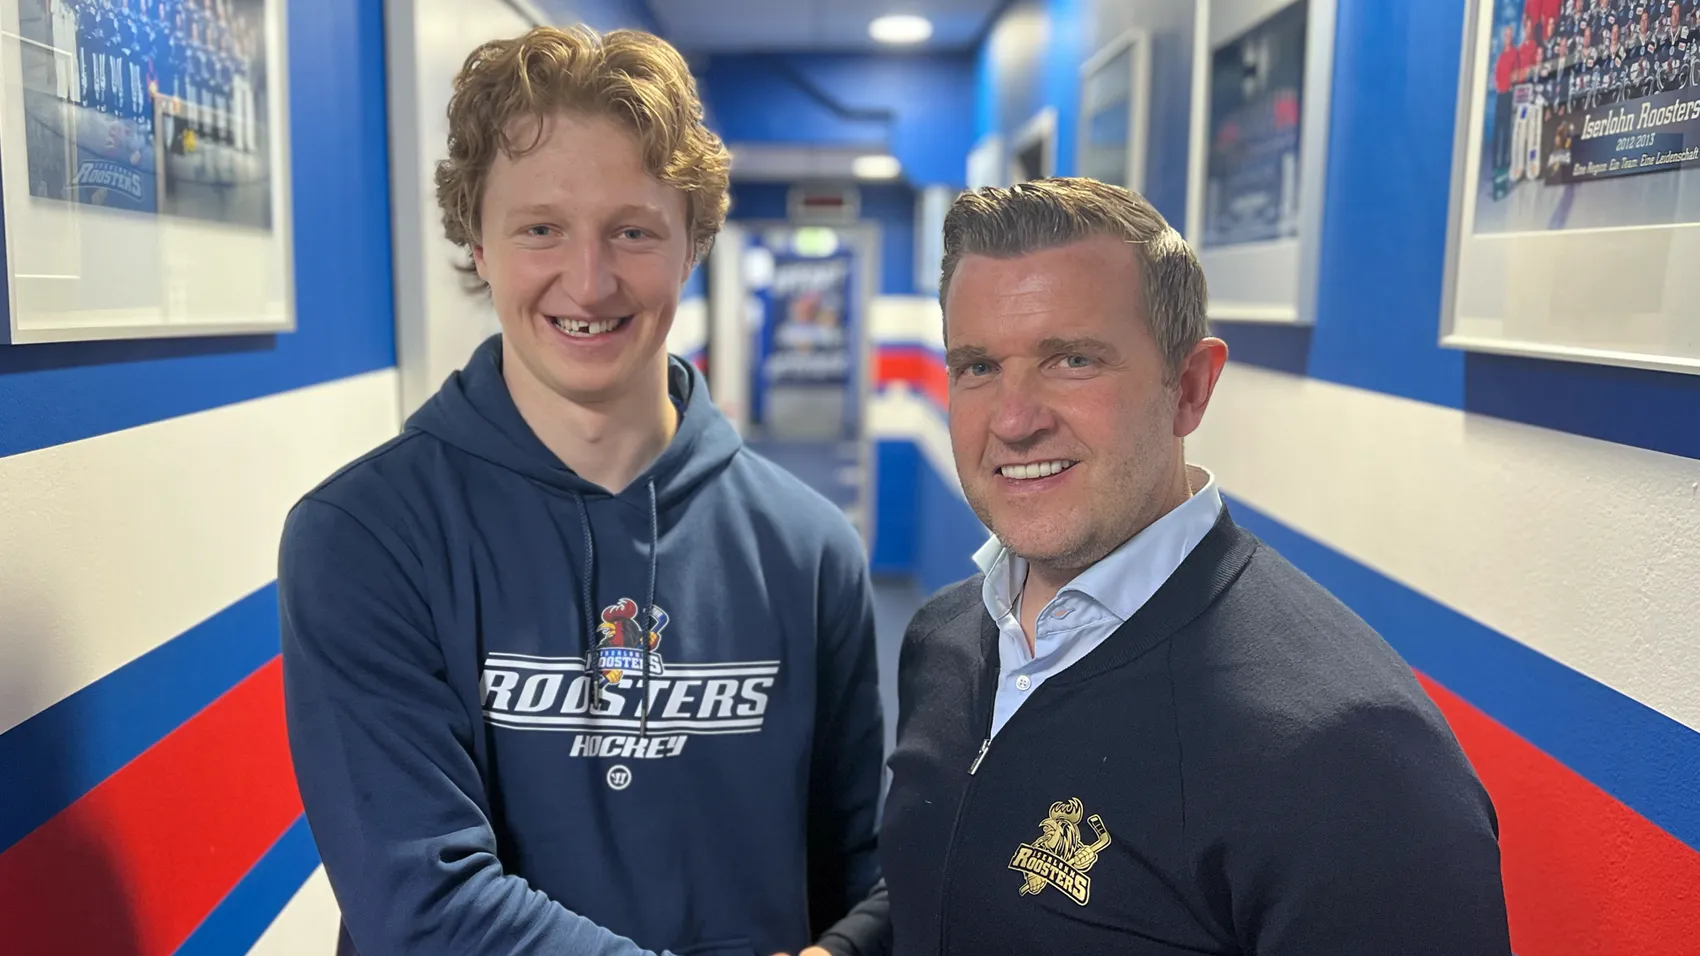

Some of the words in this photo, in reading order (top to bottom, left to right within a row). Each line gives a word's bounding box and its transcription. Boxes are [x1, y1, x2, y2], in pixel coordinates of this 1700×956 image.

[1581, 108, 1634, 140] Iserlohn
[1637, 99, 1700, 129] Roosters
[1640, 153, 1655, 167] Eine
[586, 652, 661, 674] OOSTES
[479, 670, 774, 718] ROOSTERS
[569, 735, 688, 758] HOCKEY
[1012, 847, 1088, 901] ROOSTERS
